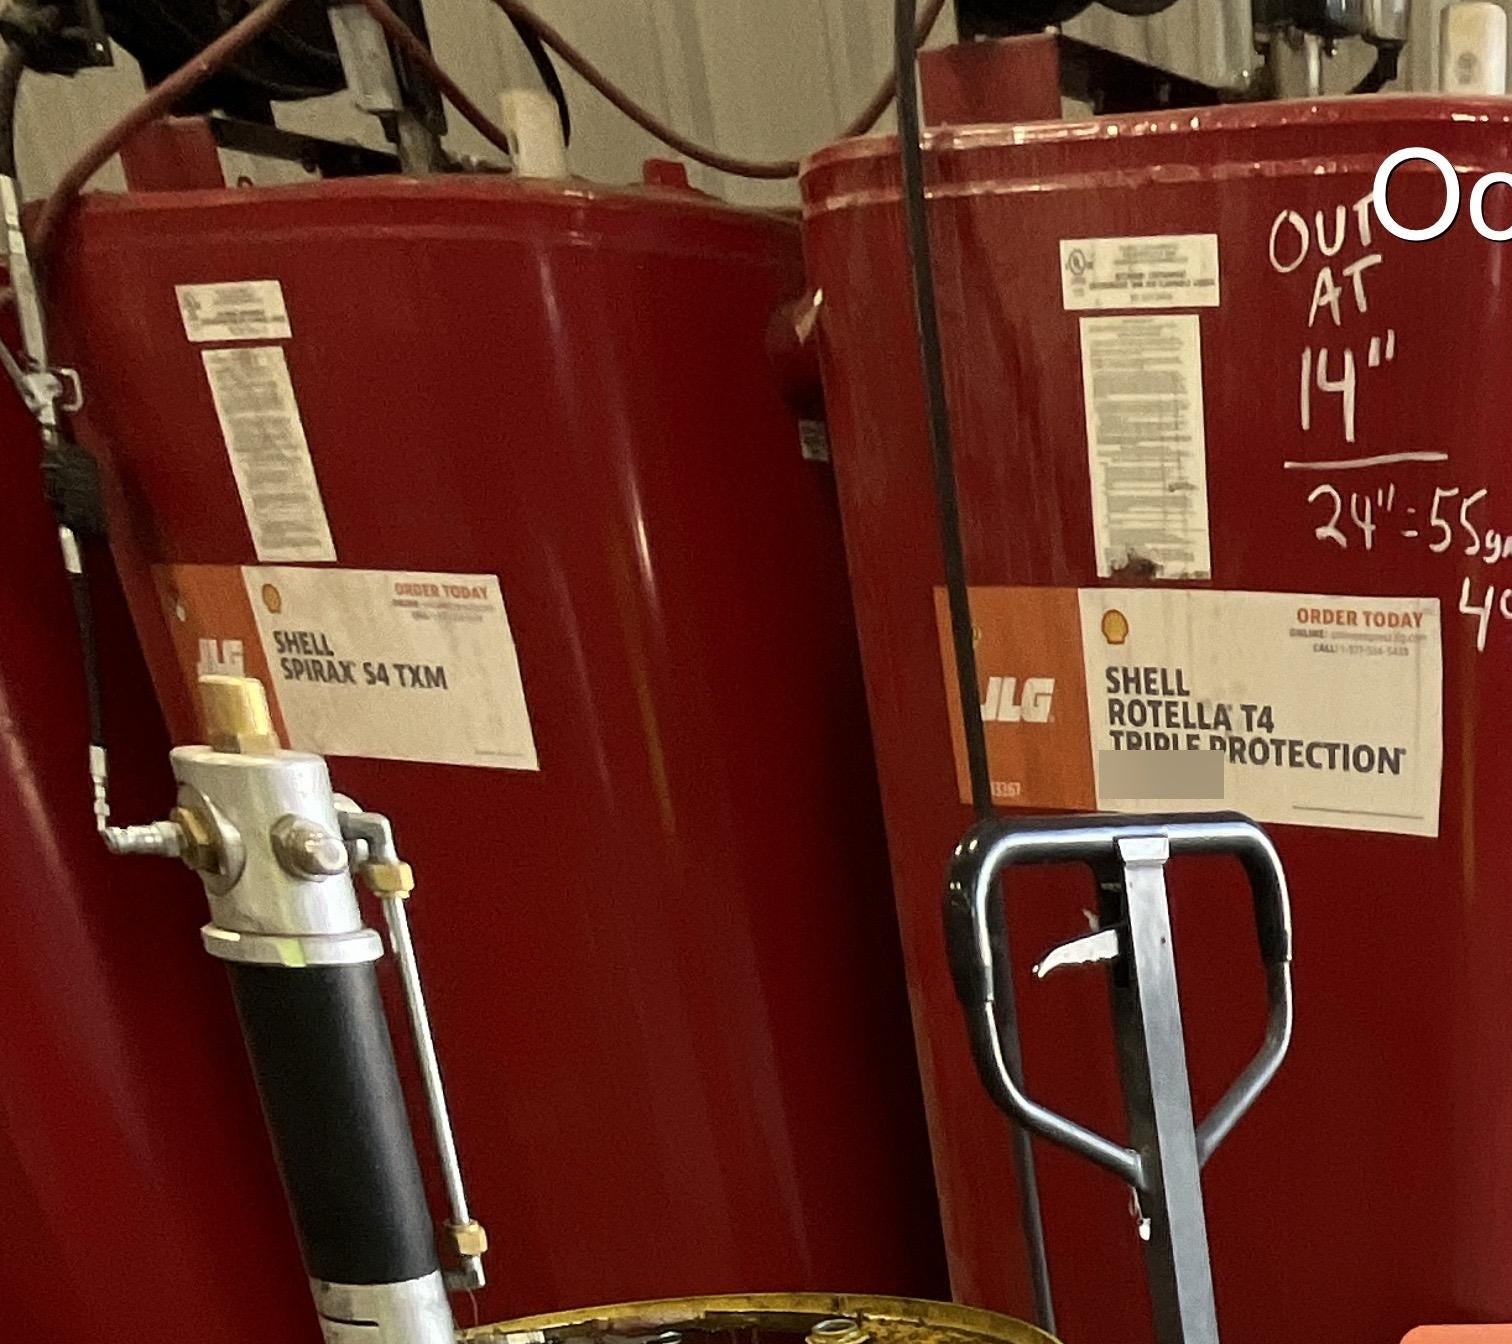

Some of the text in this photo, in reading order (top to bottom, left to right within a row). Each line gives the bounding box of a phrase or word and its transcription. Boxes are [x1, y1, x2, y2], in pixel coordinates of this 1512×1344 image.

[1269, 193, 1375, 273] OUT
[1308, 254, 1382, 327] AT
[394, 582, 488, 600] ORDER TODAY
[1297, 607, 1424, 629] ORDER TODAY
[273, 631, 335, 657] SHELL
[280, 657, 448, 690] SPIRAX S4 TXM
[1106, 666, 1191, 697] SHELL
[980, 676, 1056, 723] JLG
[1108, 699, 1275, 735] ROTELLA T4
[1209, 734, 1402, 775] PROTECTION
